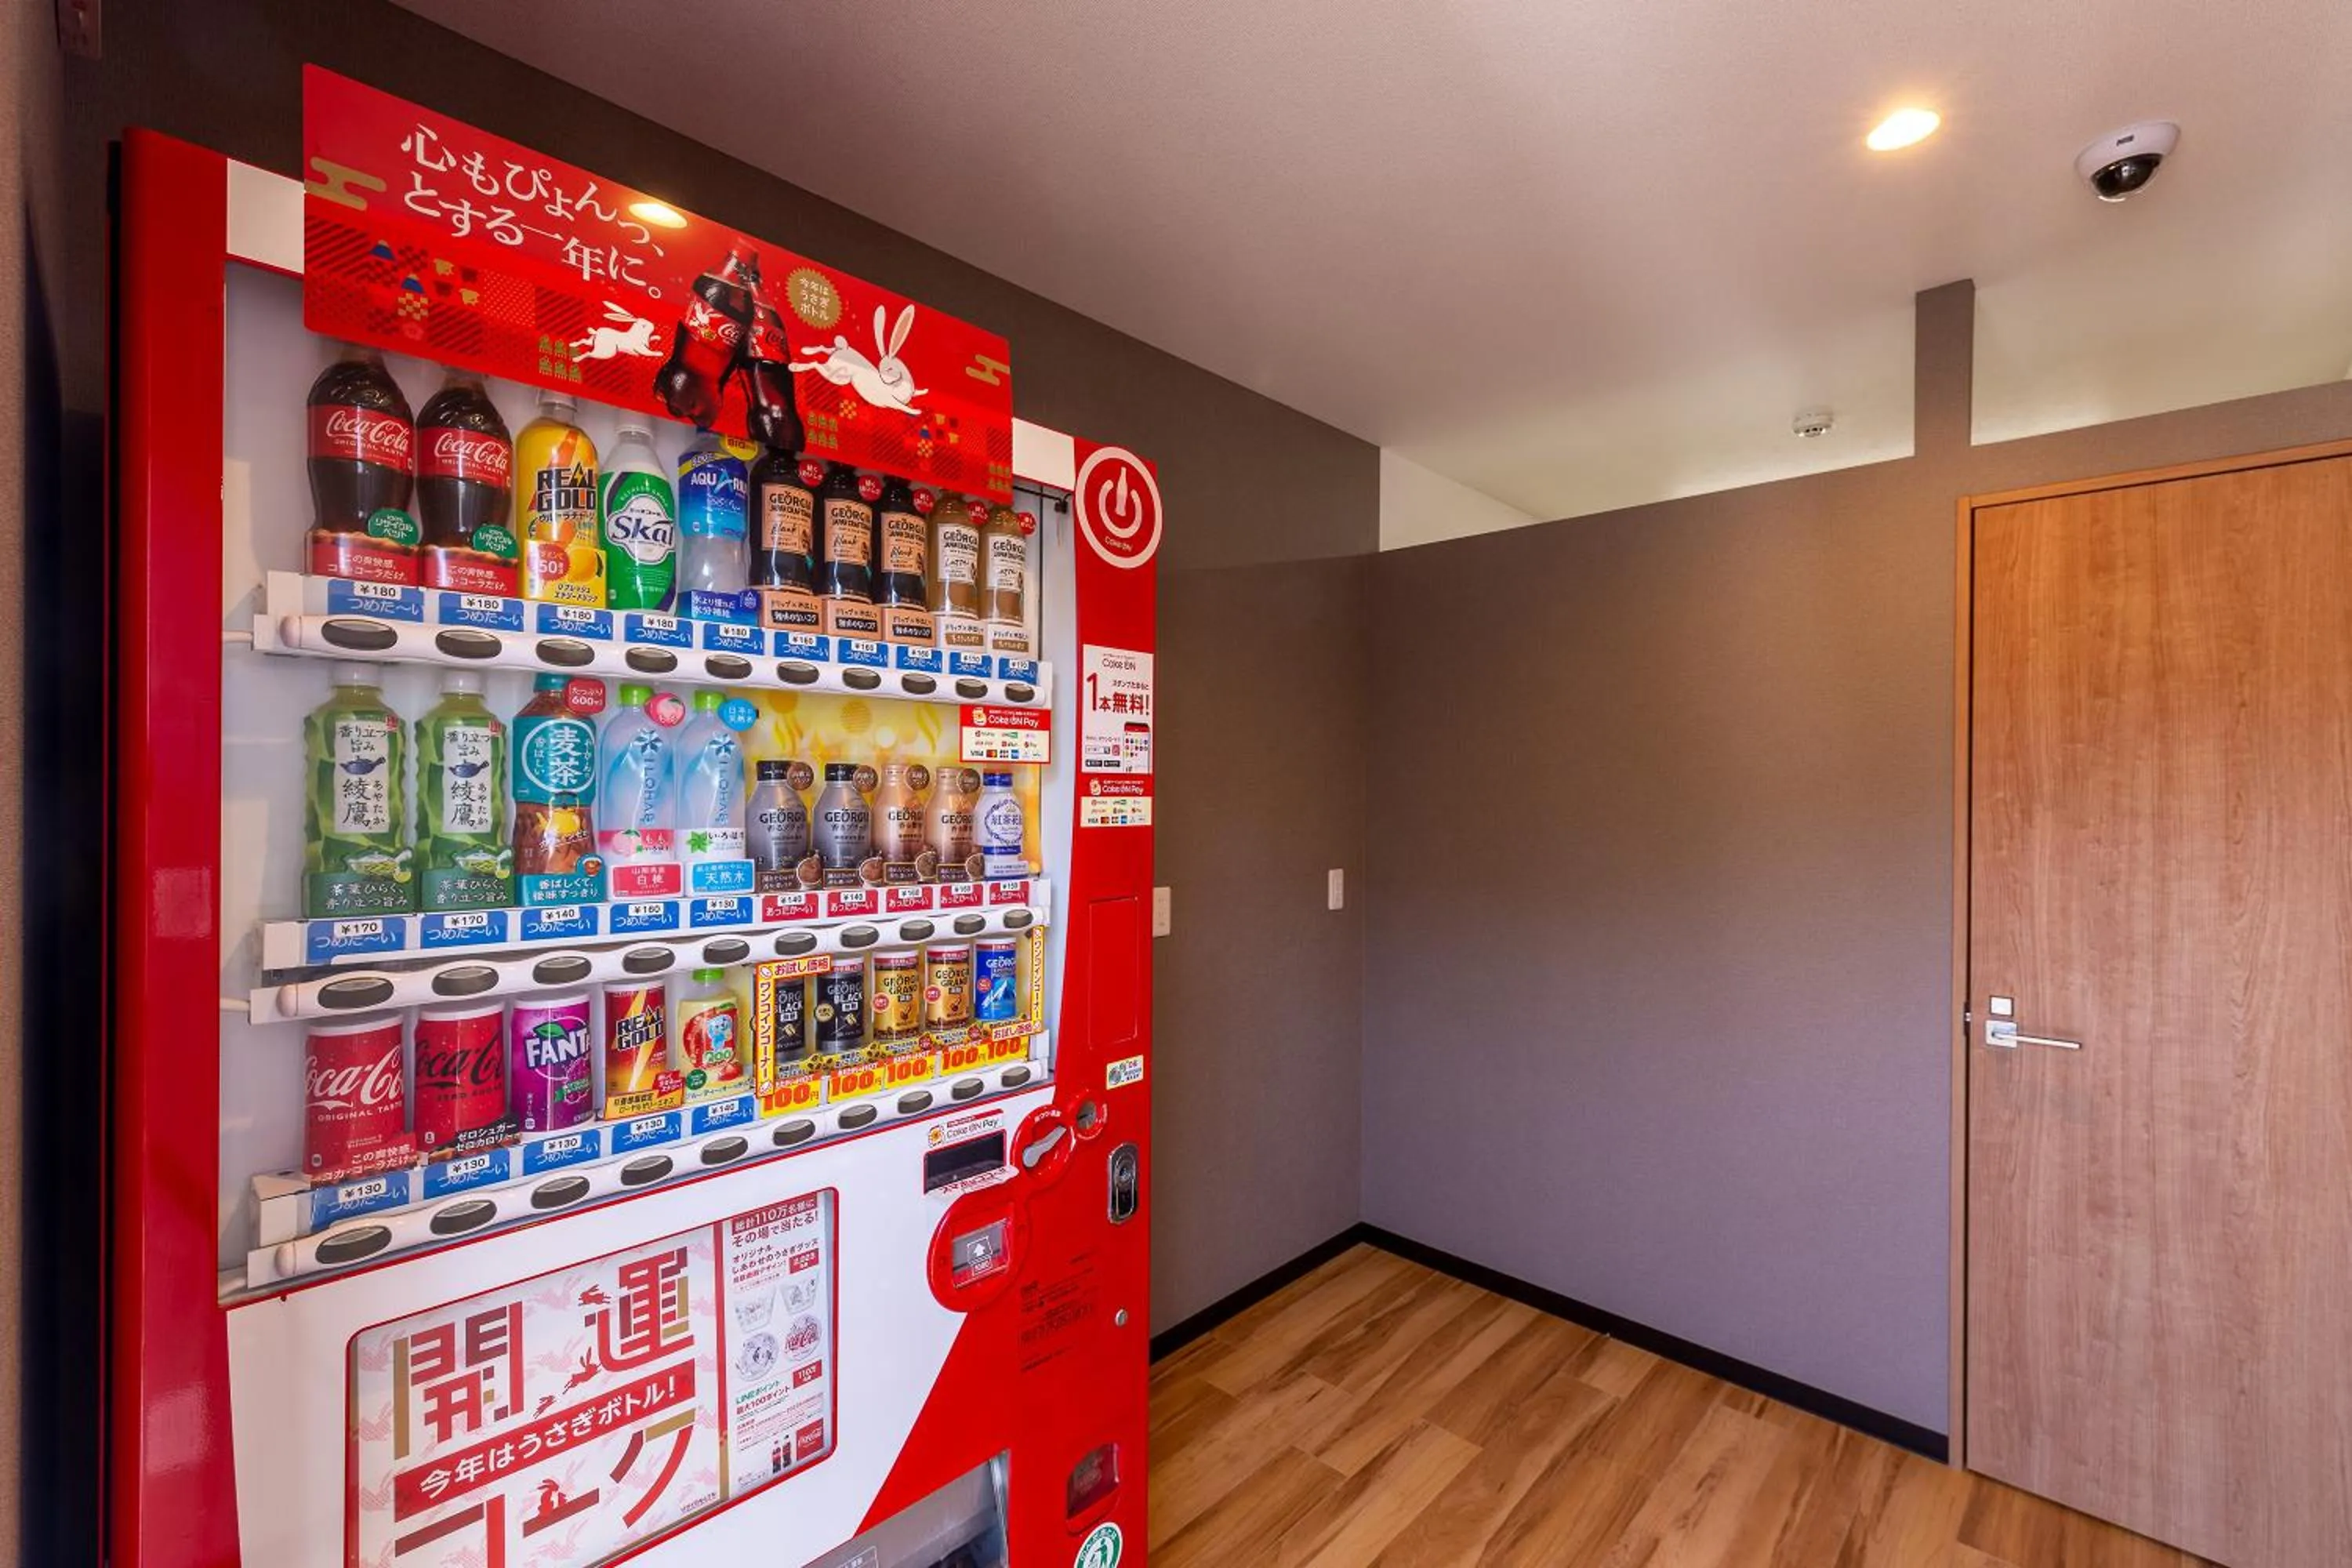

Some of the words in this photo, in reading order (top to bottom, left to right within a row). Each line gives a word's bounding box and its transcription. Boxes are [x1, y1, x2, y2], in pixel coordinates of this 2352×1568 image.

[404, 172, 662, 299] とする一年に。
[326, 410, 409, 451] Coca-Cola
[434, 432, 509, 470] Coca-Cola
[538, 461, 596, 492] REAL
[538, 489, 597, 512] GOLD
[769, 491, 811, 510] GEORGI
[831, 505, 871, 523] GEORG
[888, 518, 925, 535] GEORGI
[943, 528, 979, 545] GEORGI
[993, 539, 1025, 554] GEORG
[359, 584, 397, 597] ¥180
[466, 598, 499, 609] ¥180
[562, 609, 592, 620] ¥180
[646, 618, 673, 629] ¥180
[550, 725, 583, 786] 麦茶
[341, 777, 372, 827] 綾鷹
[450, 780, 477, 827] 綾鷹
[760, 808, 806, 824] GEORG
[824, 808, 869, 823] GEORGI
[888, 807, 923, 822] GEORG
[942, 811, 974, 824] GEORG
[706, 871, 745, 885] 天然水
[450, 914, 485, 927] ¥170
[340, 922, 378, 935] ¥170
[774, 957, 829, 976] お試し価格
[985, 956, 1016, 968] GEORG
[884, 974, 917, 987] GEORG
[935, 966, 969, 980] GEORG
[827, 981, 862, 996] GEORG
[778, 1000, 804, 1014] LACK
[760, 982, 771, 1080] ワンコインコーナー
[415, 1031, 504, 1087] oca-Co
[318, 1109, 374, 1123] ORIGINAL
[456, 1122, 517, 1142] ゼロシュガー
